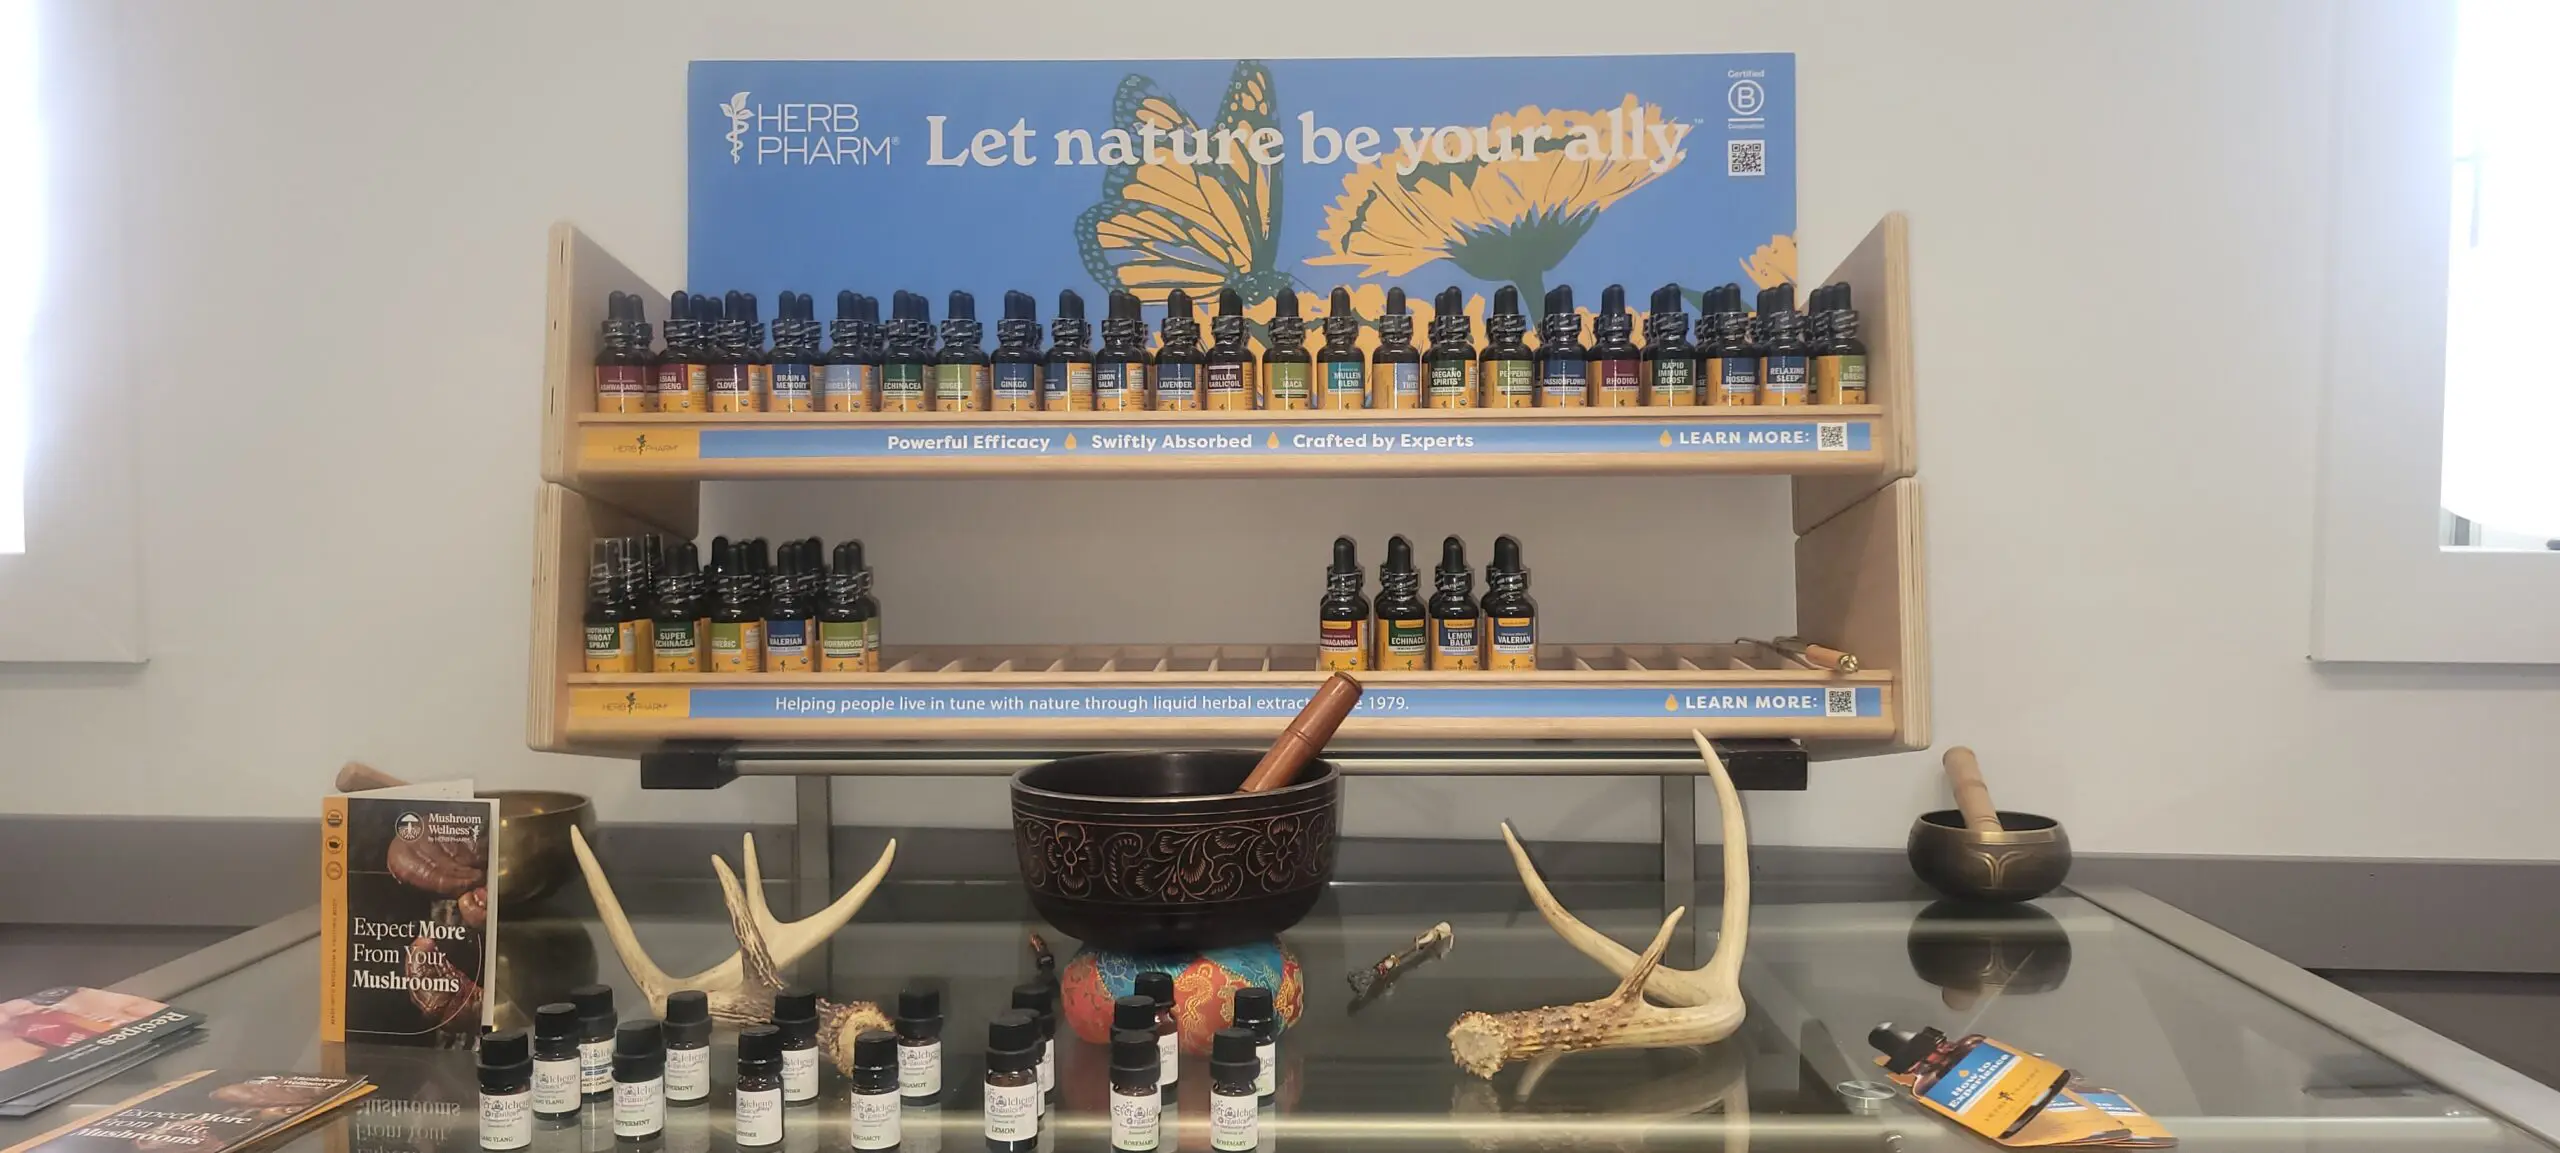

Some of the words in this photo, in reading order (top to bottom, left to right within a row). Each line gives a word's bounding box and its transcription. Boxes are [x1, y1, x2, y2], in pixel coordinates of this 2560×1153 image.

[757, 103, 860, 133] HERB
[926, 114, 1037, 167] Let
[1054, 116, 1286, 168] nature
[1297, 110, 1382, 166] be
[1393, 125, 1554, 176] your
[1661, 362, 1685, 370] RAPID
[776, 374, 799, 382] BRAIN
[1431, 370, 1462, 379] OREGANO
[1657, 369, 1690, 378] IMMUNE
[716, 380, 738, 390] CLOVE
[1000, 380, 1028, 389] GINKGO
[1158, 380, 1193, 389] LAVENDER
[1660, 376, 1686, 385] BOOST
[658, 382, 682, 390] SENG
[776, 381, 808, 390] MEMORY
[883, 381, 922, 390] ECHINACEA
[1679, 431, 1741, 444] LEARN
[1748, 431, 1810, 444] MORE:
[887, 435, 968, 450] Powerful
[973, 435, 1051, 452] Efficacy
[1091, 434, 1157, 452] Swiftly
[1161, 433, 1252, 449] Absorbed
[1292, 433, 1367, 449] Crafted
[1372, 433, 1396, 451] by
[1400, 433, 1474, 450] Experts
[659, 632, 687, 640] SUPER
[1447, 631, 1473, 640] LEMON
[1497, 635, 1531, 644] VALERIAN
[769, 637, 803, 646] VALERIAN
[1320, 638, 1358, 646] AGANDHA
[1391, 637, 1426, 645] ECHINACE
[1449, 638, 1471, 647] BALM
[775, 697, 836, 713] Helping
[840, 696, 895, 713] people
[899, 695, 927, 711] live
[930, 696, 945, 711] in
[949, 696, 986, 711] tune
[990, 695, 1025, 711] with
[1029, 696, 1081, 711] nature
[1085, 695, 1148, 713] through
[1153, 696, 1198, 713] liquid
[1202, 695, 1252, 711] herbal
[1368, 696, 1410, 711] 1979.
[1685, 695, 1749, 709] LEARN
[1755, 695, 1818, 709] MORE:
[428, 812, 482, 824] Mushroom
[428, 824, 471, 835] Wellness
[353, 917, 416, 940] Expect
[419, 920, 467, 940] More
[353, 944, 400, 963] From
[404, 946, 447, 967] Your
[352, 969, 461, 993] Mushrooms
[96, 1011, 189, 1047] Recipes
[1947, 1053, 2011, 1109] Experience
[1950, 1072, 1979, 1098] How
[190, 1112, 253, 1125] More
[991, 1125, 1016, 1135] LEMON
[70, 1126, 206, 1146] Mushrooms
[1216, 1138, 1247, 1147] ROSEMARY
